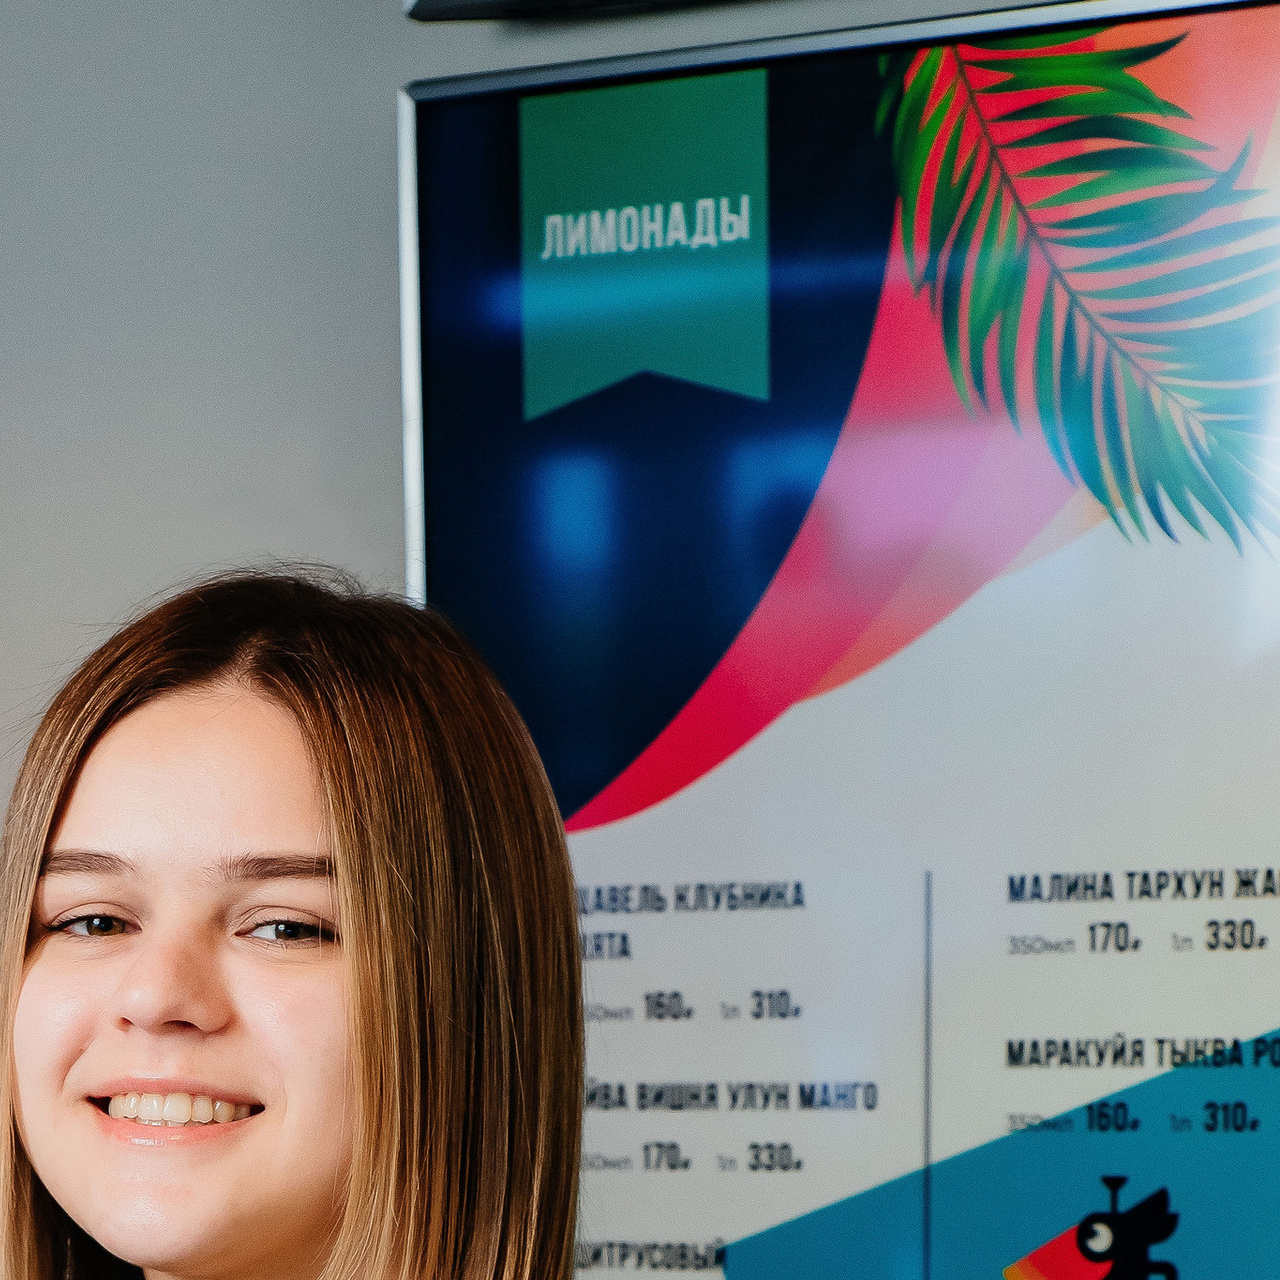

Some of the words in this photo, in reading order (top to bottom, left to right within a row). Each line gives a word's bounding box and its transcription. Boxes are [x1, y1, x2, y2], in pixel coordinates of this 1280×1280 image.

[541, 194, 750, 260] ЛИМОНАДЫ
[674, 881, 804, 911] КЛУБНИКА
[1007, 873, 1115, 902] МАЛИНА
[1126, 869, 1224, 900] ТАРХУН
[1006, 1033, 1145, 1069] МАРАКУЙЯ
[1155, 1038, 1243, 1069] ТЫКВА
[585, 1076, 627, 1110] ЙВА
[636, 1082, 718, 1111] ВИШНЯ
[727, 1081, 790, 1110] УЛУН
[798, 1081, 878, 1111] МАНГО
